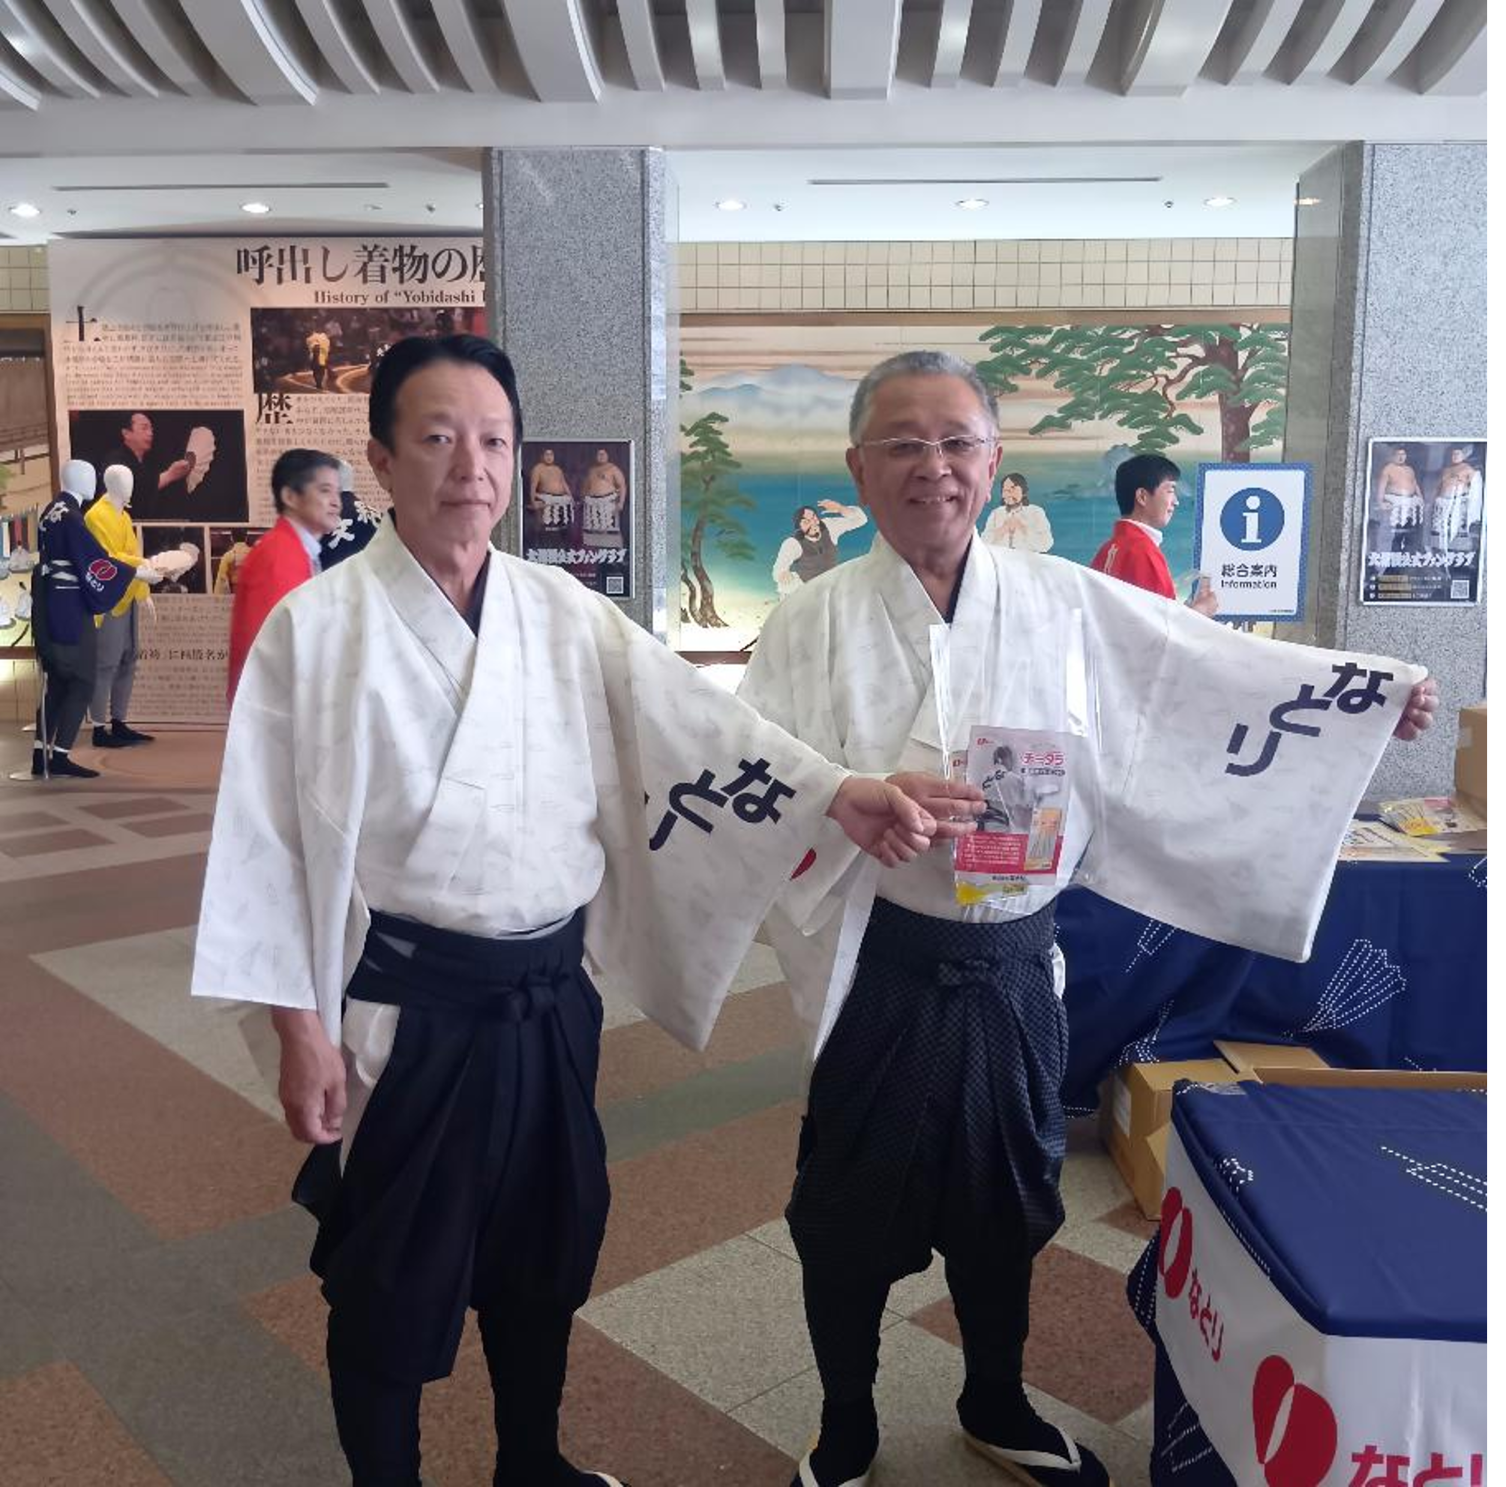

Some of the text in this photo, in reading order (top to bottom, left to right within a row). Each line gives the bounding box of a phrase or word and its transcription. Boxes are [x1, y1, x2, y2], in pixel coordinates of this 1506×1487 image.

[314, 290, 371, 305] History
[375, 290, 390, 304] of
[1221, 563, 1277, 577] 総合案内
[1221, 580, 1277, 589] Information
[1225, 662, 1394, 776] なとり
[1189, 1267, 1224, 1362] なとり
